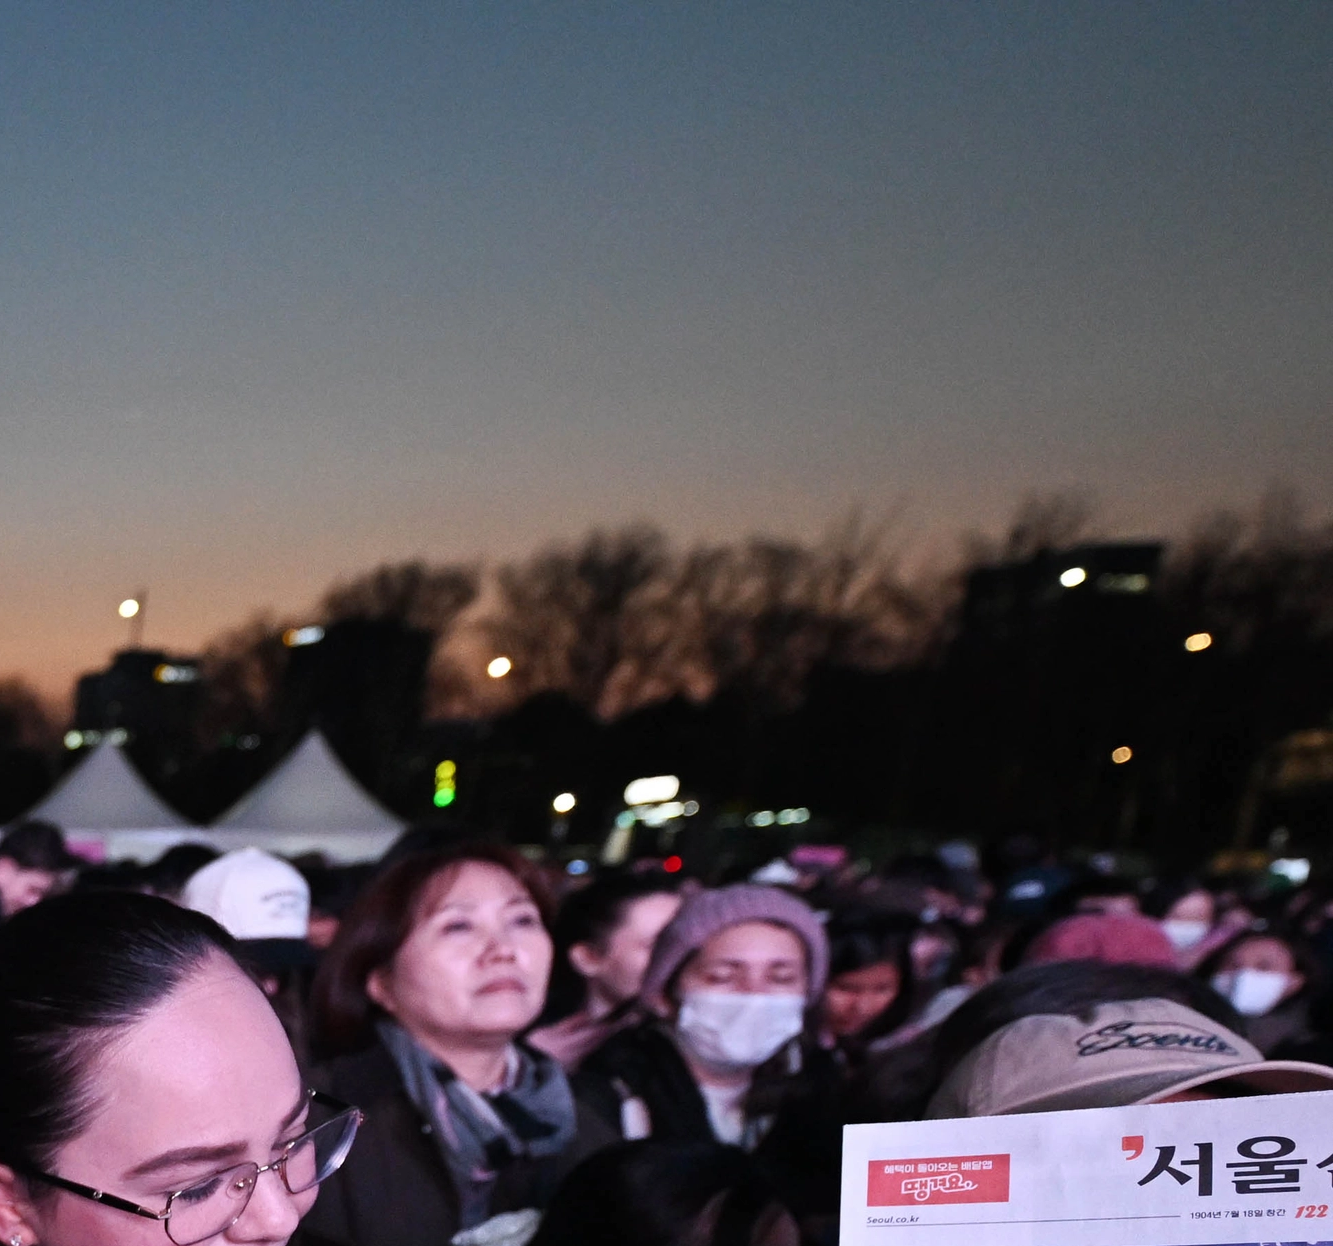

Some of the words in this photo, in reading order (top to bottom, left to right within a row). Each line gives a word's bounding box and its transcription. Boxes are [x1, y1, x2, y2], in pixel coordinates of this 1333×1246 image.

[916, 1161, 958, 1173] 돌아오는
[959, 1159, 993, 1171] 배달앱
[1136, 1135, 1333, 1197] 서울
[900, 1171, 978, 1201] 땡겨요
[1190, 1210, 1222, 1220] 1904년
[1224, 1209, 1240, 1218] 7월
[1242, 1208, 1264, 1218] 18일
[1265, 1207, 1286, 1217] 창간
[1294, 1203, 1329, 1219] 122
